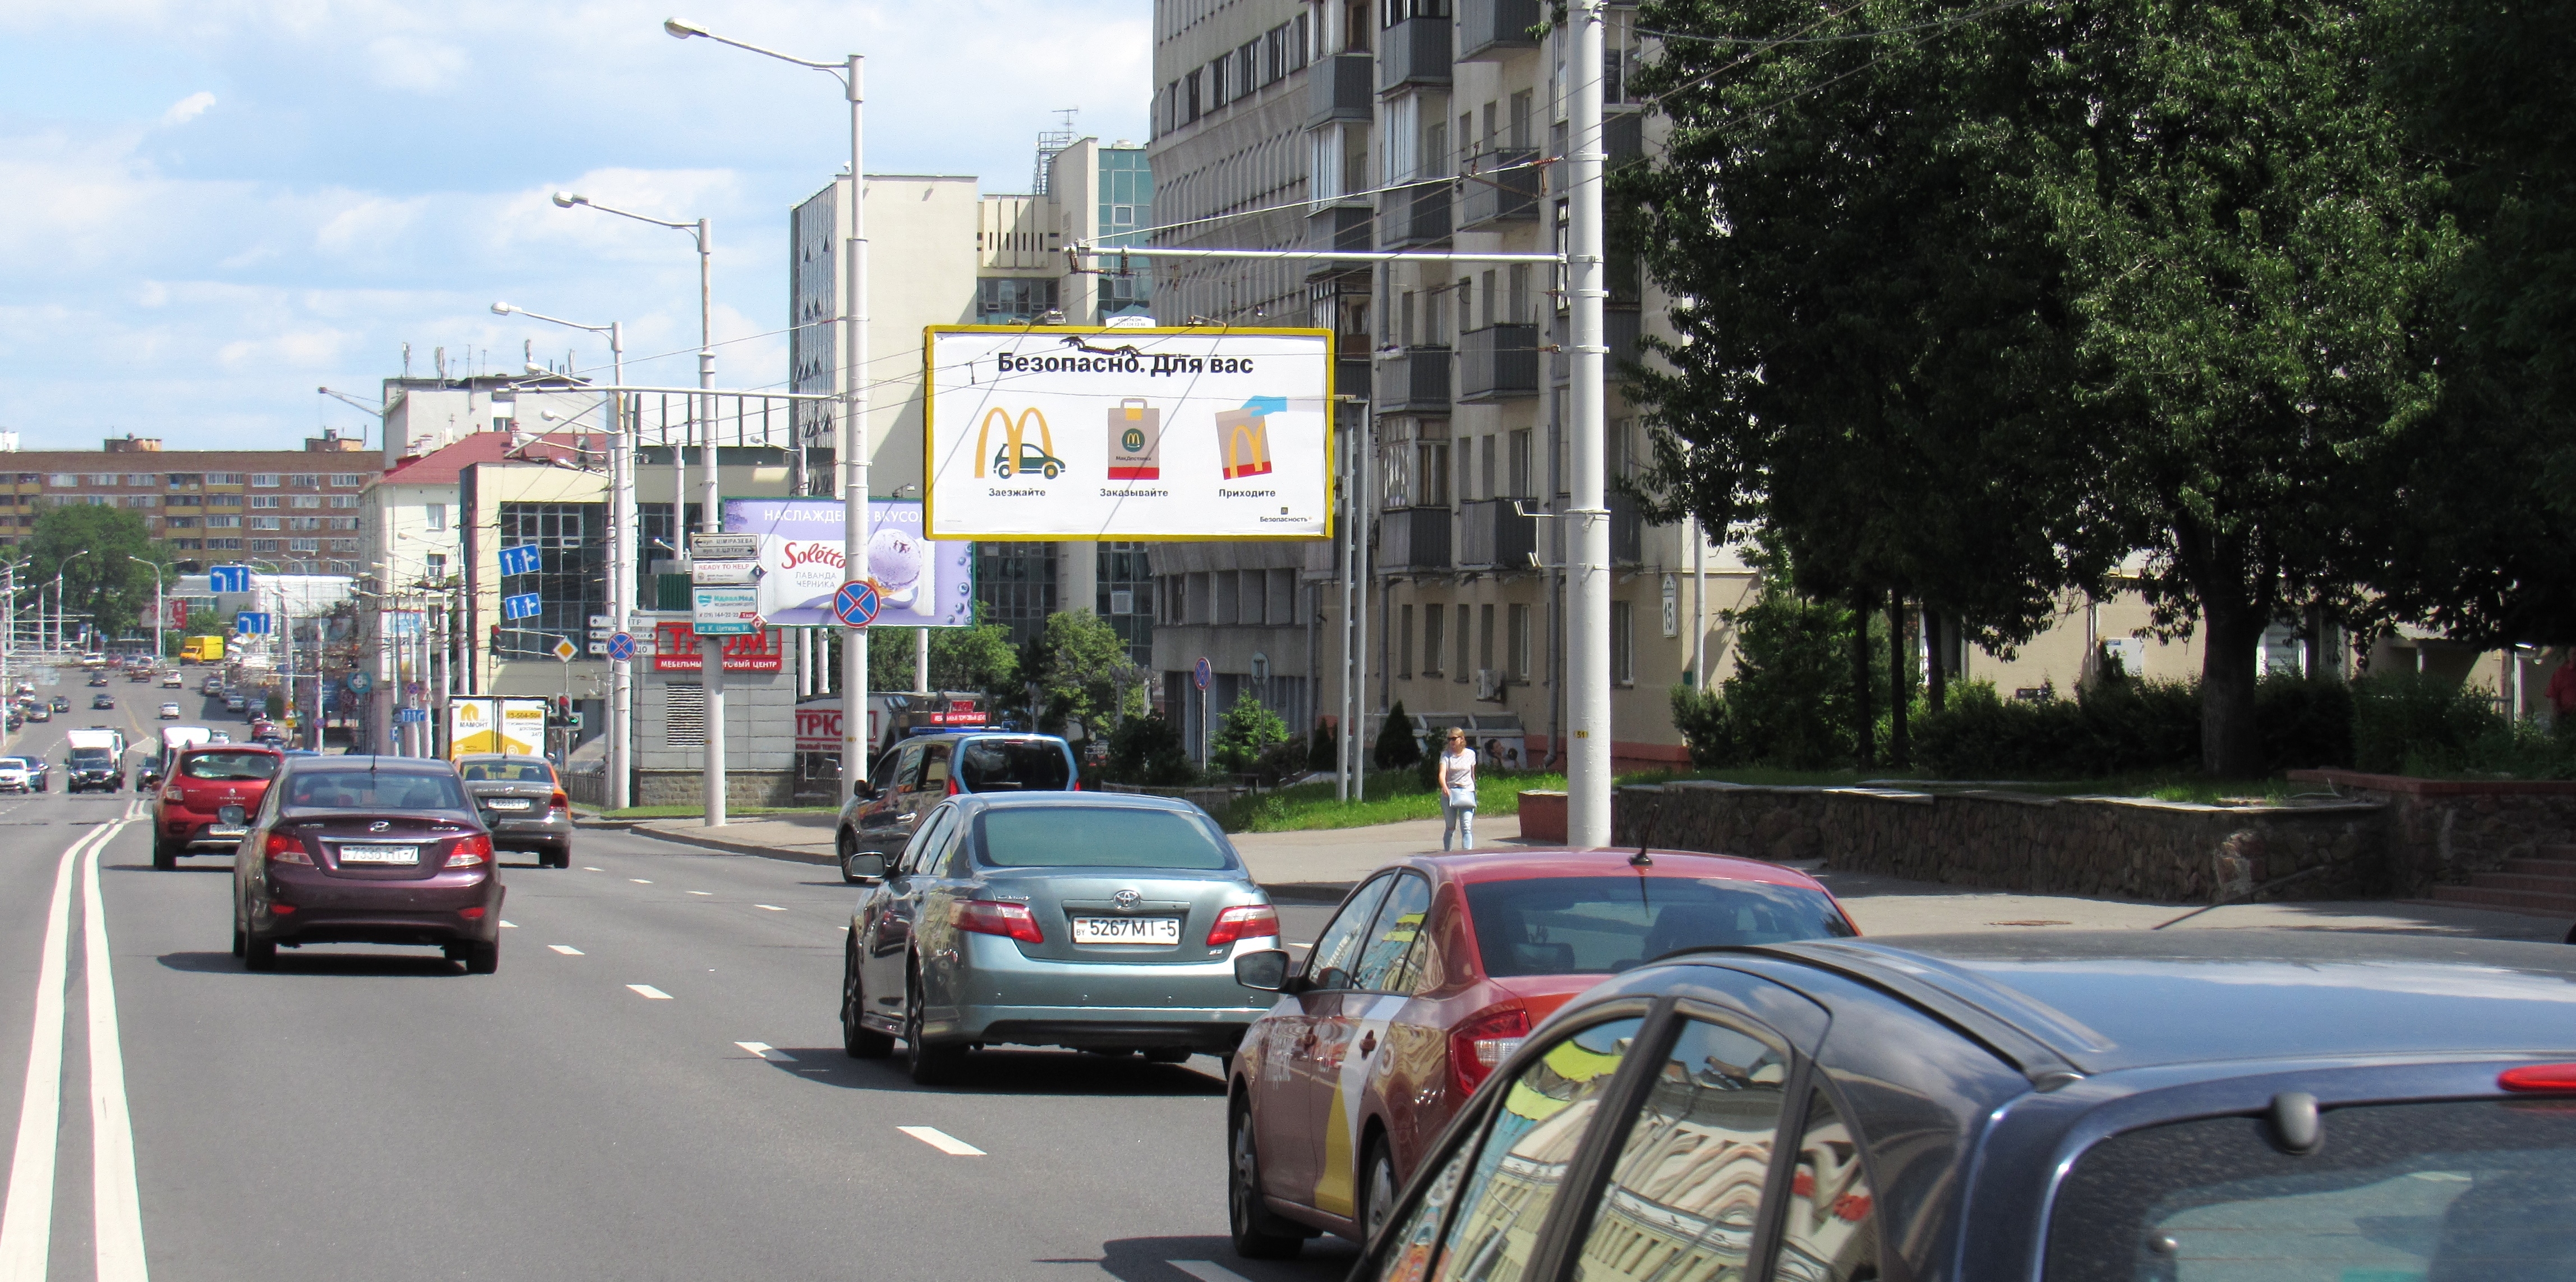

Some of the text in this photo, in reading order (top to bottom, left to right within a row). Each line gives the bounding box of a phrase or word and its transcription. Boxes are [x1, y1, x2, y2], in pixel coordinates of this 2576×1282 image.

[998, 352, 1254, 377] Безопасно. Для вас
[988, 488, 1046, 498] Заезжайте
[1099, 488, 1169, 497] Заказывайте
[1219, 489, 1276, 499] Приходите
[874, 511, 923, 523] ВКУСО
[795, 571, 837, 580] ЛАВАНДА
[796, 580, 836, 589] ЧЕРНИКА
[1664, 602, 1672, 630] 15
[795, 714, 842, 736] ТРЮ
